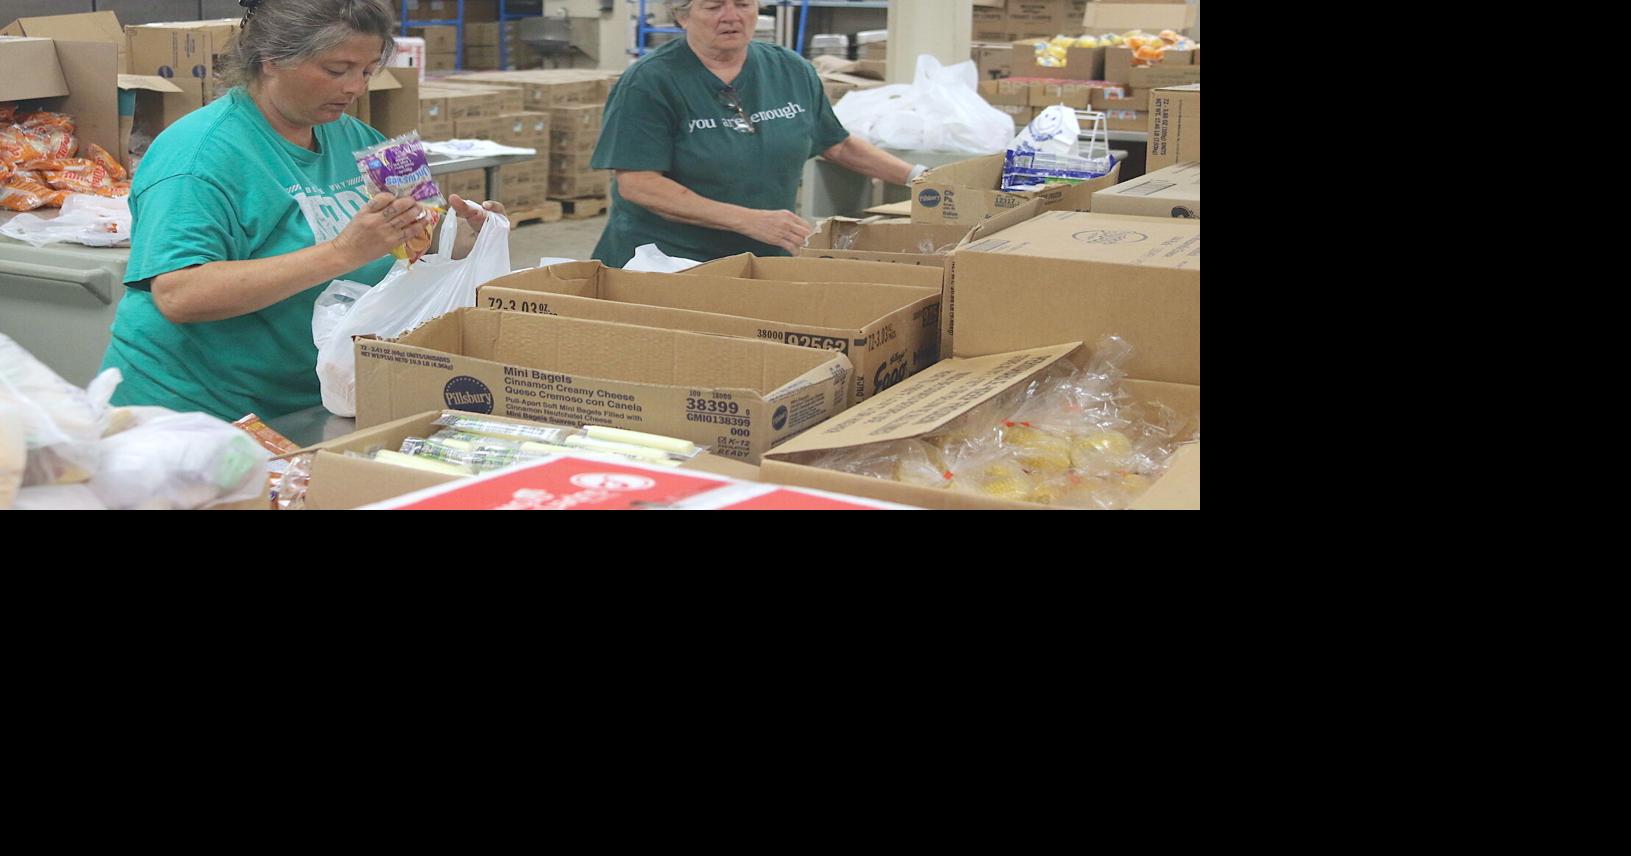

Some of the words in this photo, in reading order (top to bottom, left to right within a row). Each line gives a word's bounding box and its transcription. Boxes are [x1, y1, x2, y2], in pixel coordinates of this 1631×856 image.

[688, 118, 717, 133] you
[750, 102, 806, 123] enough.
[756, 328, 784, 341] 38000
[504, 366, 528, 378] Mini
[532, 370, 572, 384] Bagels
[504, 377, 554, 390] Cinnamon
[556, 384, 594, 397] Creamy
[597, 390, 635, 402] Cheese
[446, 391, 492, 406] Pillsbury
[505, 386, 536, 397] Queso
[539, 391, 584, 404] Cremoso
[586, 398, 604, 407] con
[608, 401, 642, 412] Canela
[686, 398, 739, 414] 38399
[506, 396, 542, 408] Pull-Apart
[543, 402, 558, 410] Soft
[576, 406, 601, 416] Bagels
[604, 410, 625, 419] Filled
[626, 414, 642, 422] with
[506, 404, 542, 414] Cinnamon
[584, 414, 612, 424] Cheese
[523, 412, 548, 422] Bagels
[687, 413, 751, 427] GMI0138399
[731, 428, 750, 436] 000
[728, 438, 750, 446] K-12
